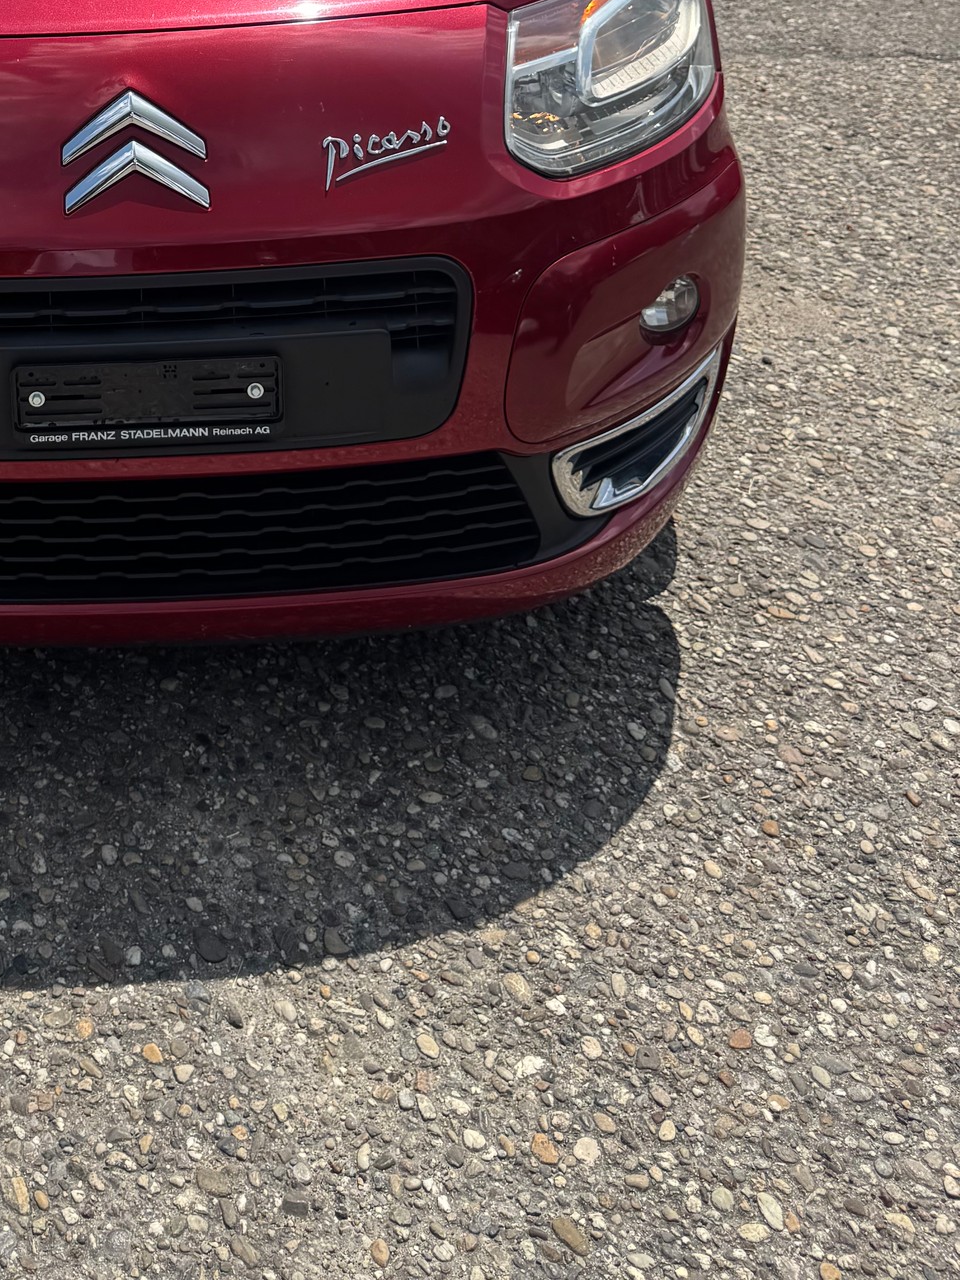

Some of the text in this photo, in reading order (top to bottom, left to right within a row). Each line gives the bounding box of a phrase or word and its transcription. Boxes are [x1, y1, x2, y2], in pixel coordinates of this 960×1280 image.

[322, 115, 452, 192] Picasso
[29, 425, 271, 443] Garage FRANZ STADELMANN Reinach AG
